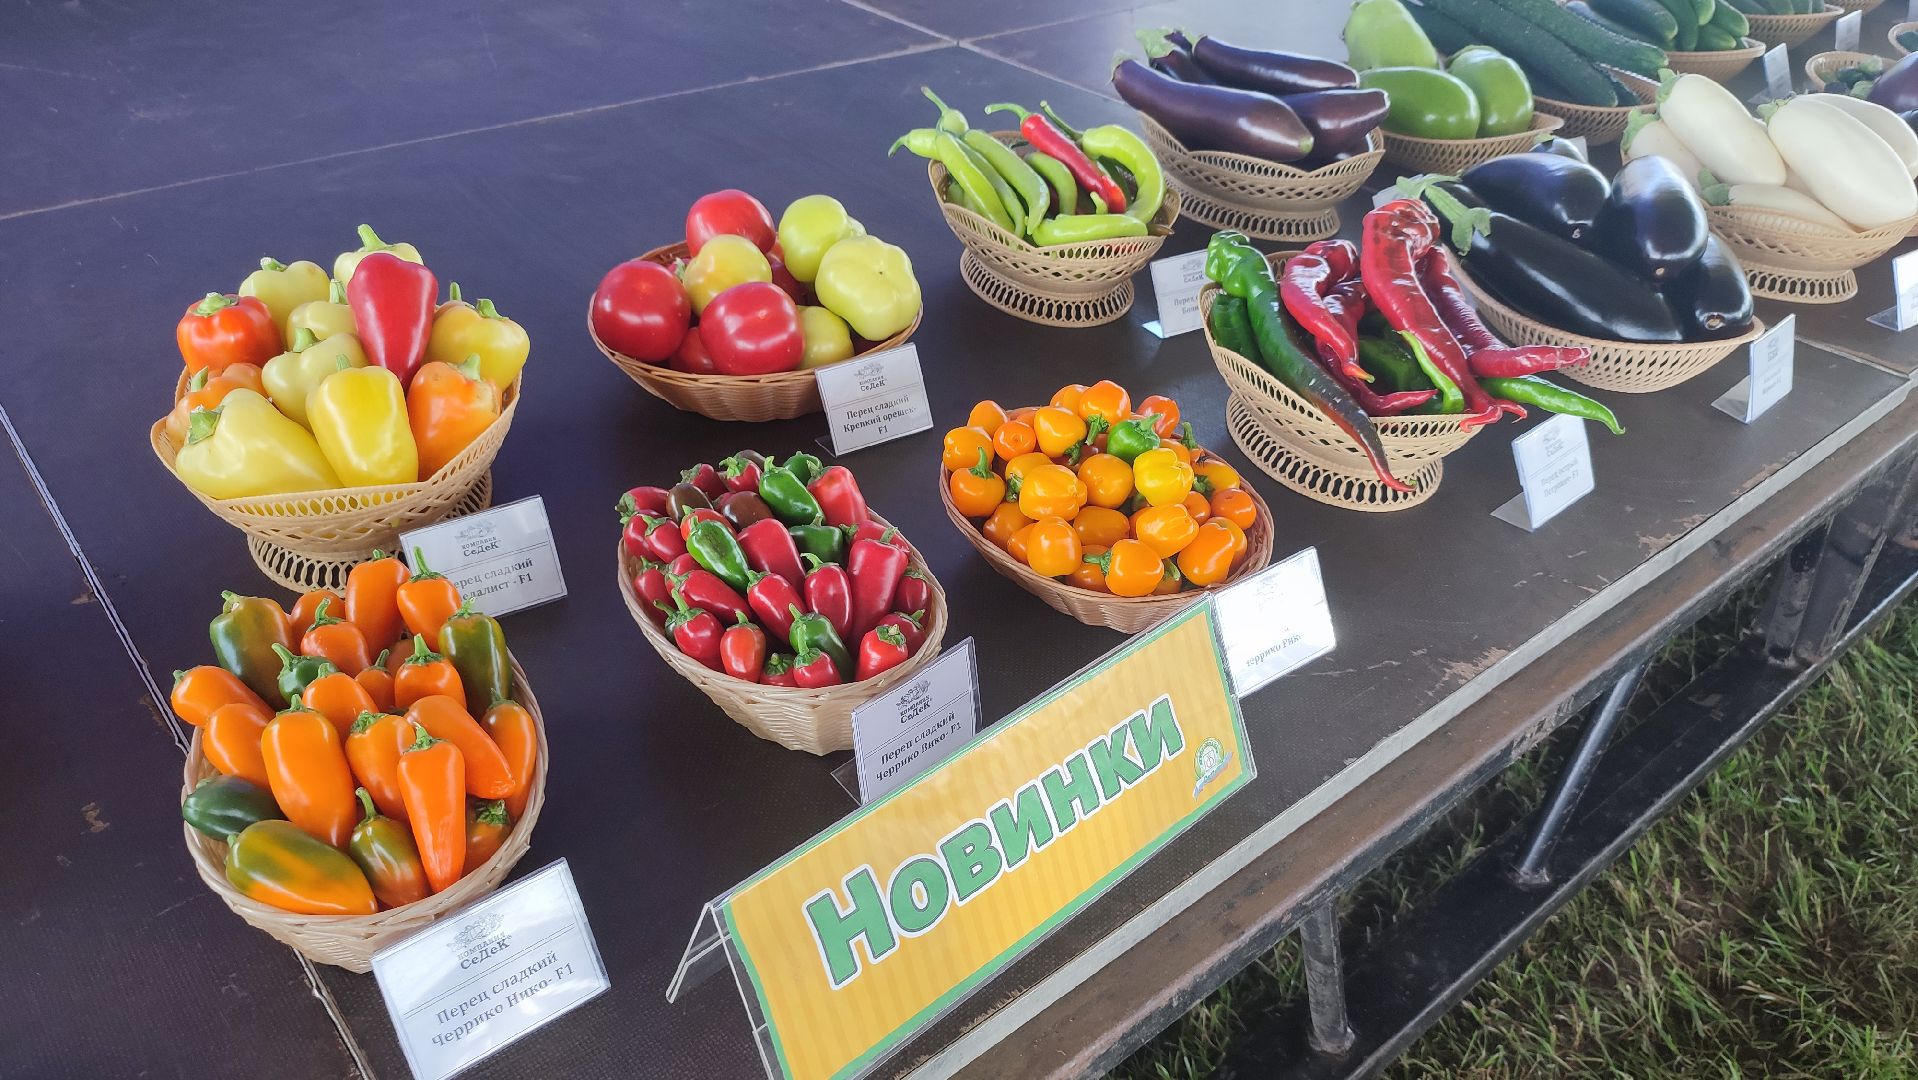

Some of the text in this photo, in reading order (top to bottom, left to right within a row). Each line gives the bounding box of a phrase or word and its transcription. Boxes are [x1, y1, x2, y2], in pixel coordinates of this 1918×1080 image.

[843, 414, 881, 432] Крепкий
[847, 395, 909, 420] Перец сладкий
[878, 425, 888, 434] F1
[463, 541, 500, 557] СеДеК
[454, 558, 534, 590] ерец сладкий
[462, 581, 510, 601] едалист
[519, 573, 533, 585] F1
[881, 711, 955, 764] Перец сладкий
[876, 750, 920, 781] Черрико
[460, 938, 510, 970] СеДеК
[435, 951, 559, 1025] Перец сладкий
[432, 963, 575, 1046] Черрико Нико- F1
